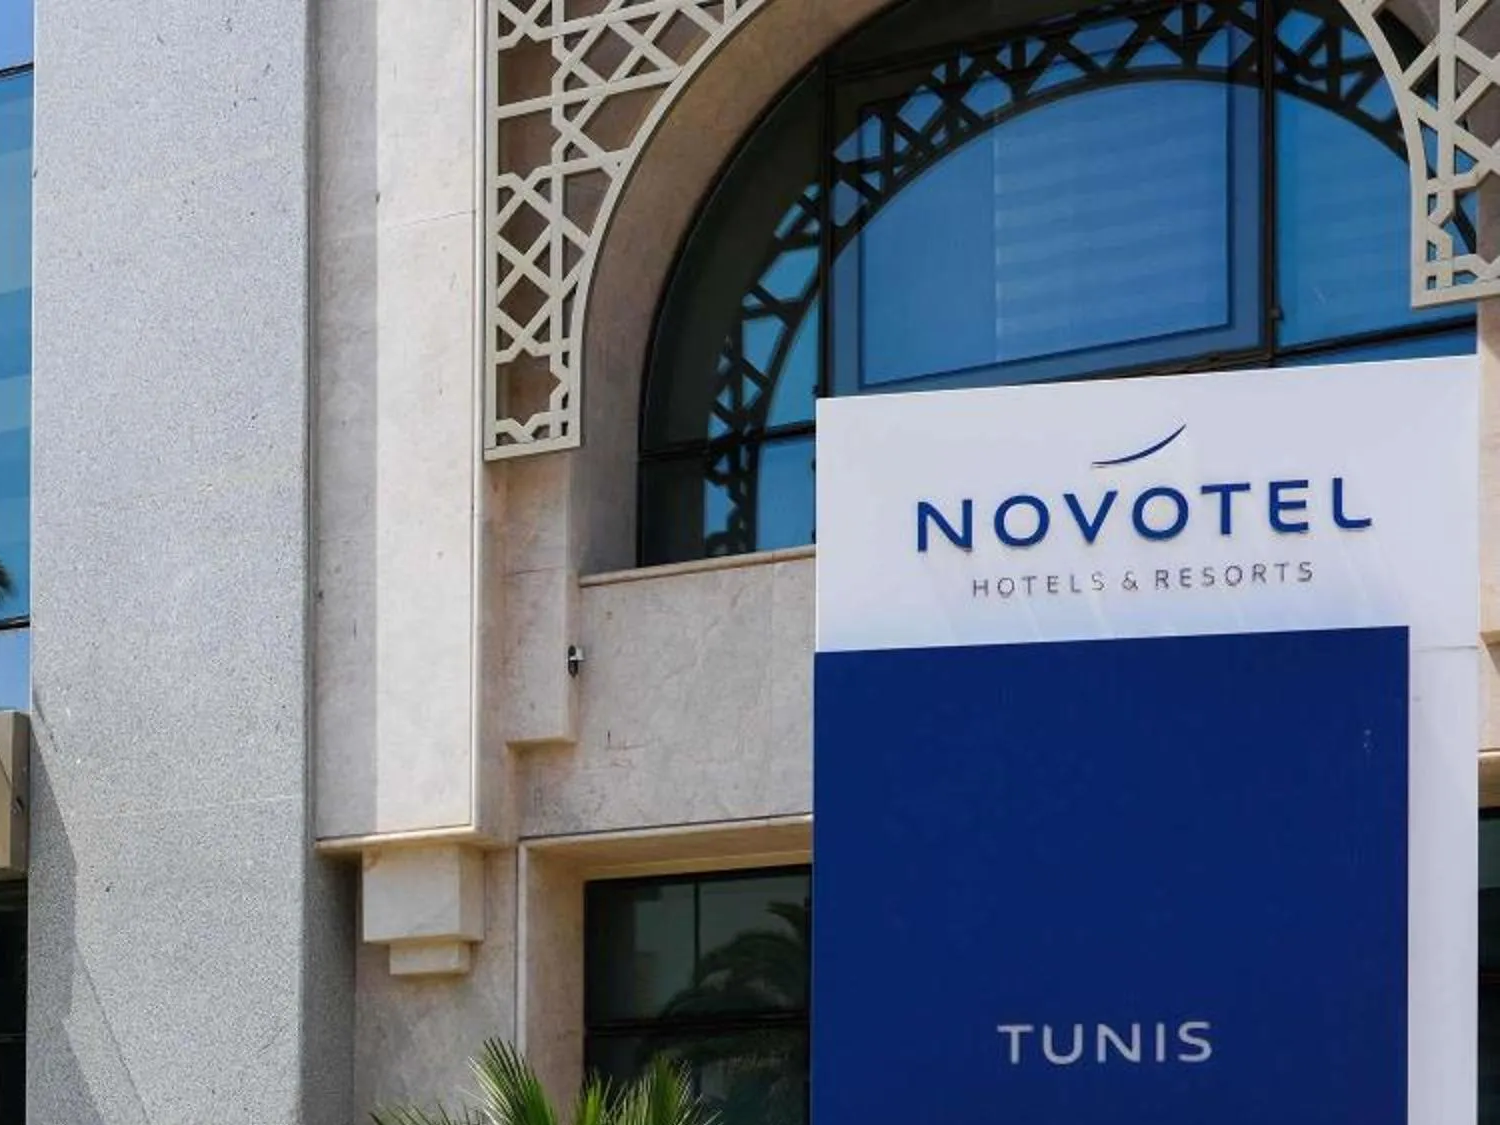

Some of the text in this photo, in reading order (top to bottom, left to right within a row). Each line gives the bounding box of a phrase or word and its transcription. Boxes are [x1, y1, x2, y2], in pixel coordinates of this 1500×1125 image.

[917, 477, 1373, 553] NOVOTEL
[972, 561, 1315, 598] HOTELS & RESORTS
[997, 1021, 1213, 1065] TUNIS
